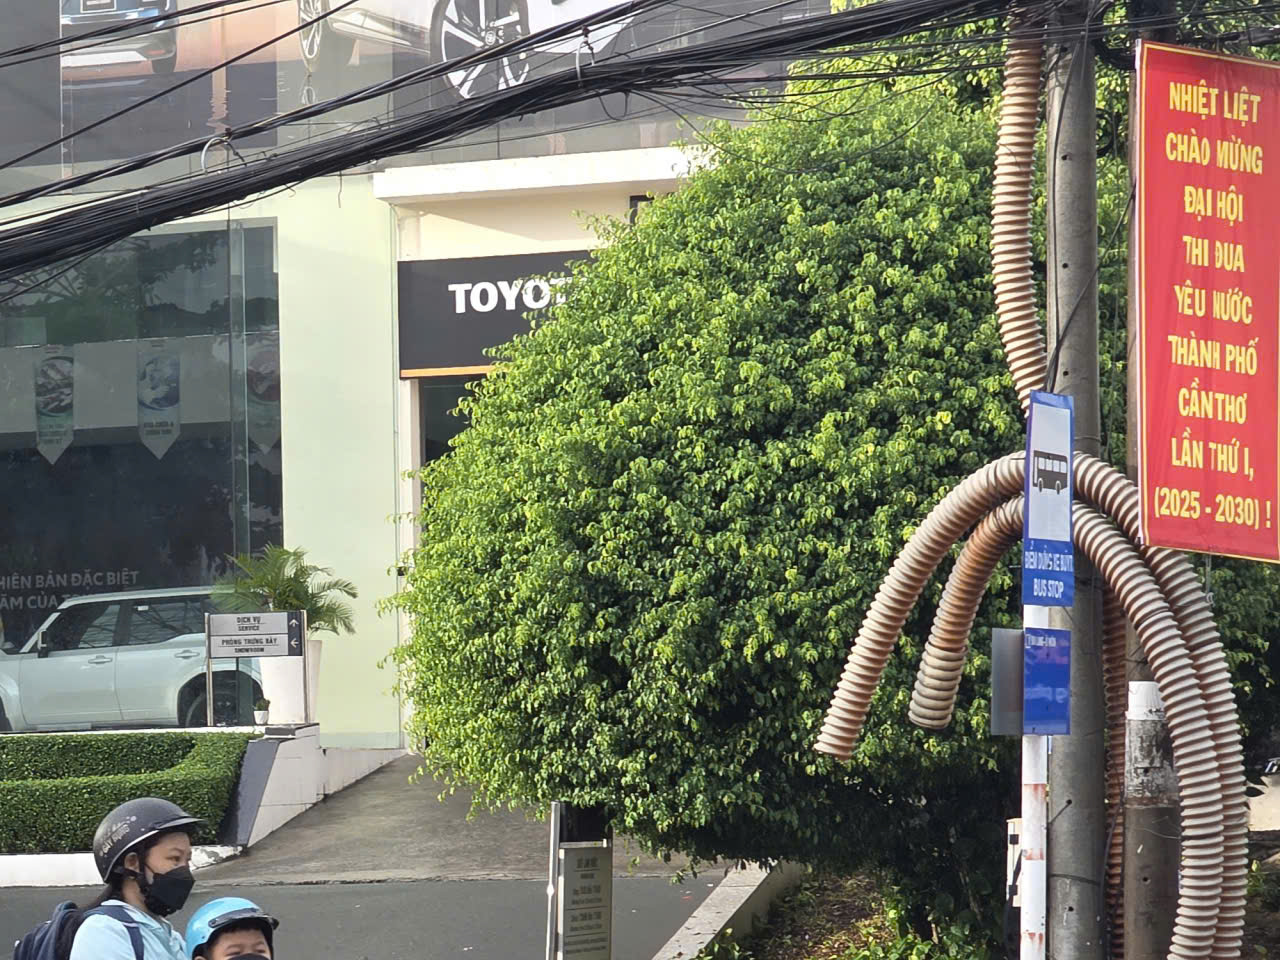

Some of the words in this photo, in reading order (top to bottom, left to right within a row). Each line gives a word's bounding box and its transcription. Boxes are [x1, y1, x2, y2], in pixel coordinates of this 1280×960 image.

[1169, 79, 1219, 120] NHIỆT
[1224, 86, 1261, 127] LIỆT
[1166, 128, 1210, 166] CHÀO
[1217, 135, 1263, 174] MỪNG
[1184, 185, 1213, 222] ĐẠI
[1217, 185, 1243, 227] HỘI
[1183, 235, 1209, 267] THI
[1215, 241, 1245, 272] ĐUA
[1174, 280, 1206, 317] YÊU
[1213, 286, 1253, 325] NƯỚC
[1167, 331, 1221, 370] THÀNH
[1226, 337, 1259, 376] PHỐ
[1178, 377, 1213, 419] CẦN
[1215, 393, 1248, 424] THƠ
[1171, 427, 1203, 469] LẦN
[1209, 437, 1240, 475] THỨ
[1244, 447, 1254, 481] I,
[1154, 487, 1201, 519] (2025
[1215, 495, 1260, 530] 2030)
[27, 592, 58, 608] CỦA
[36, 571, 67, 588] BẢN
[71, 569, 104, 588] ĐẶC
[106, 568, 139, 586] BIỆT
[1033, 578, 1047, 597] BUS
[1048, 580, 1064, 598] STOP
